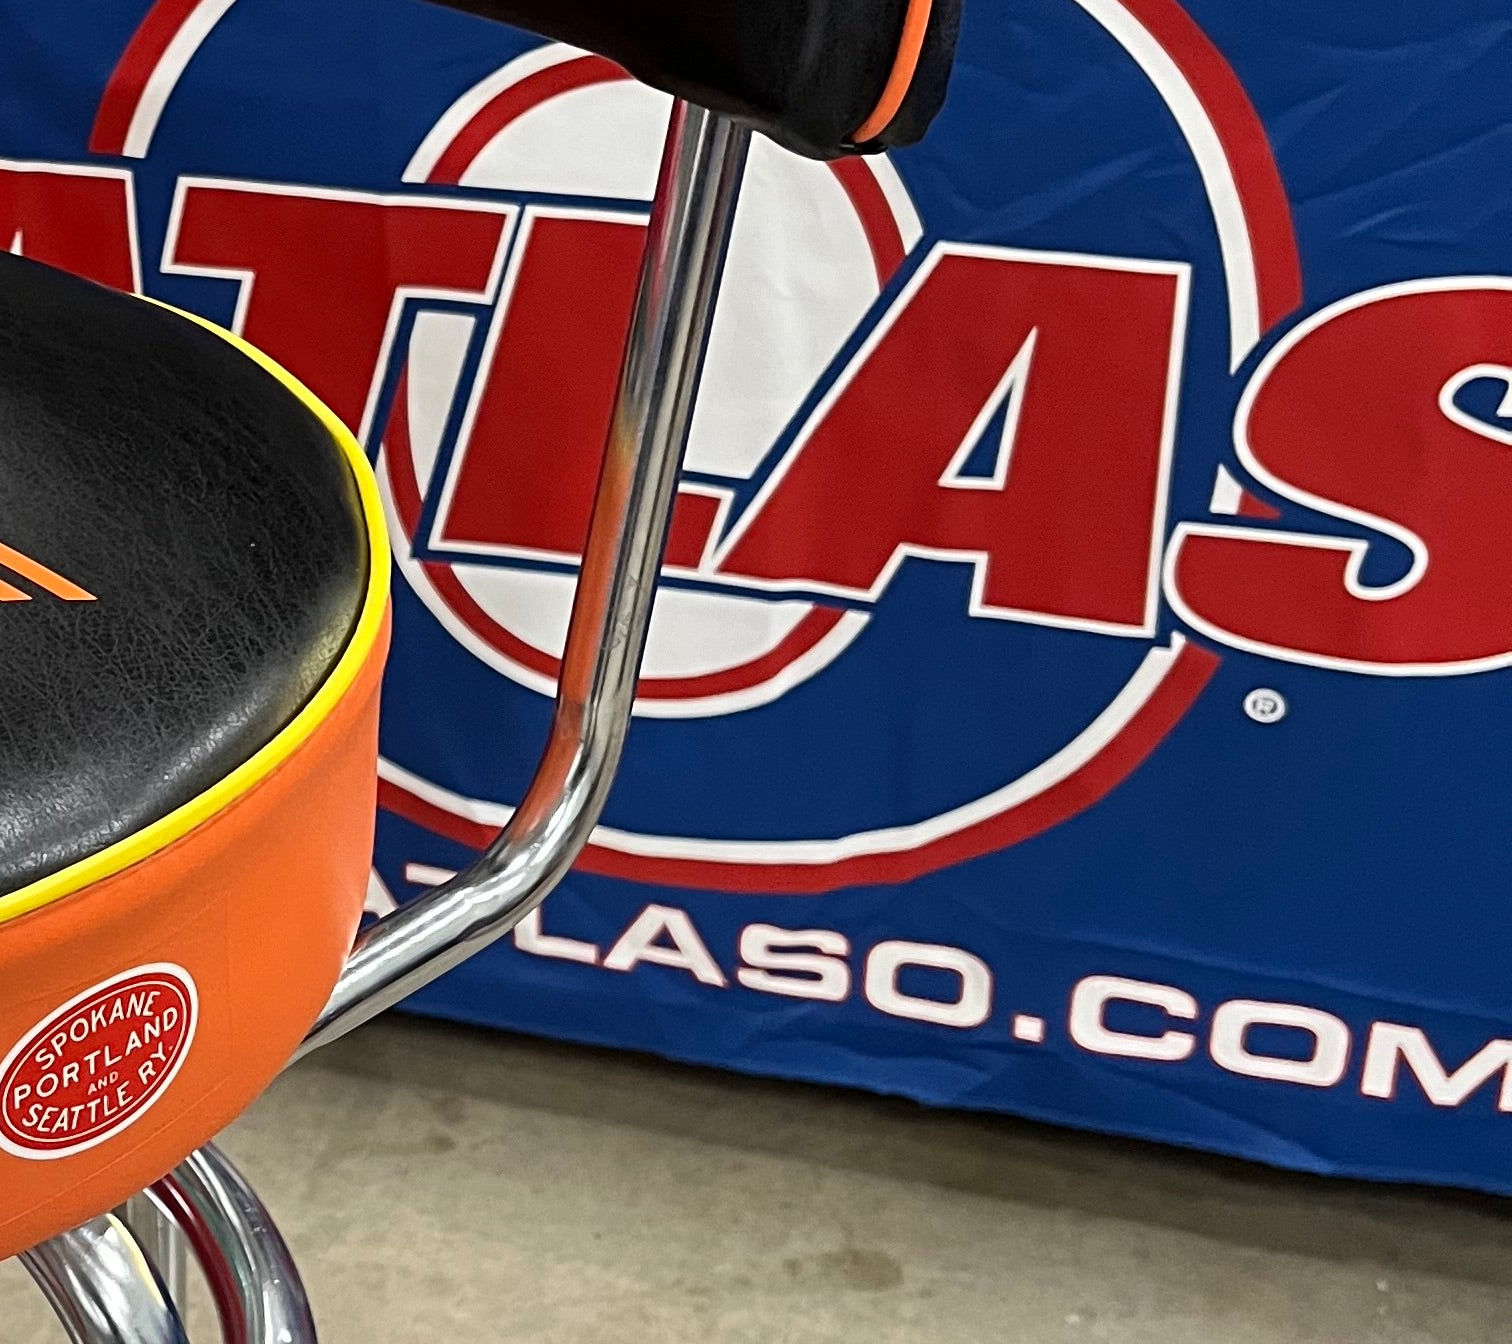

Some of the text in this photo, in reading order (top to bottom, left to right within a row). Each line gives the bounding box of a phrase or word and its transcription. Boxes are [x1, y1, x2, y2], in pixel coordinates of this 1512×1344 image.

[364, 862, 1512, 1113] LASO.COM
[13, 1006, 179, 1110] PORTLAND
[34, 990, 162, 1071] SPOKANE
[21, 1079, 134, 1134] SEATTLE
[87, 1070, 119, 1096] AND
